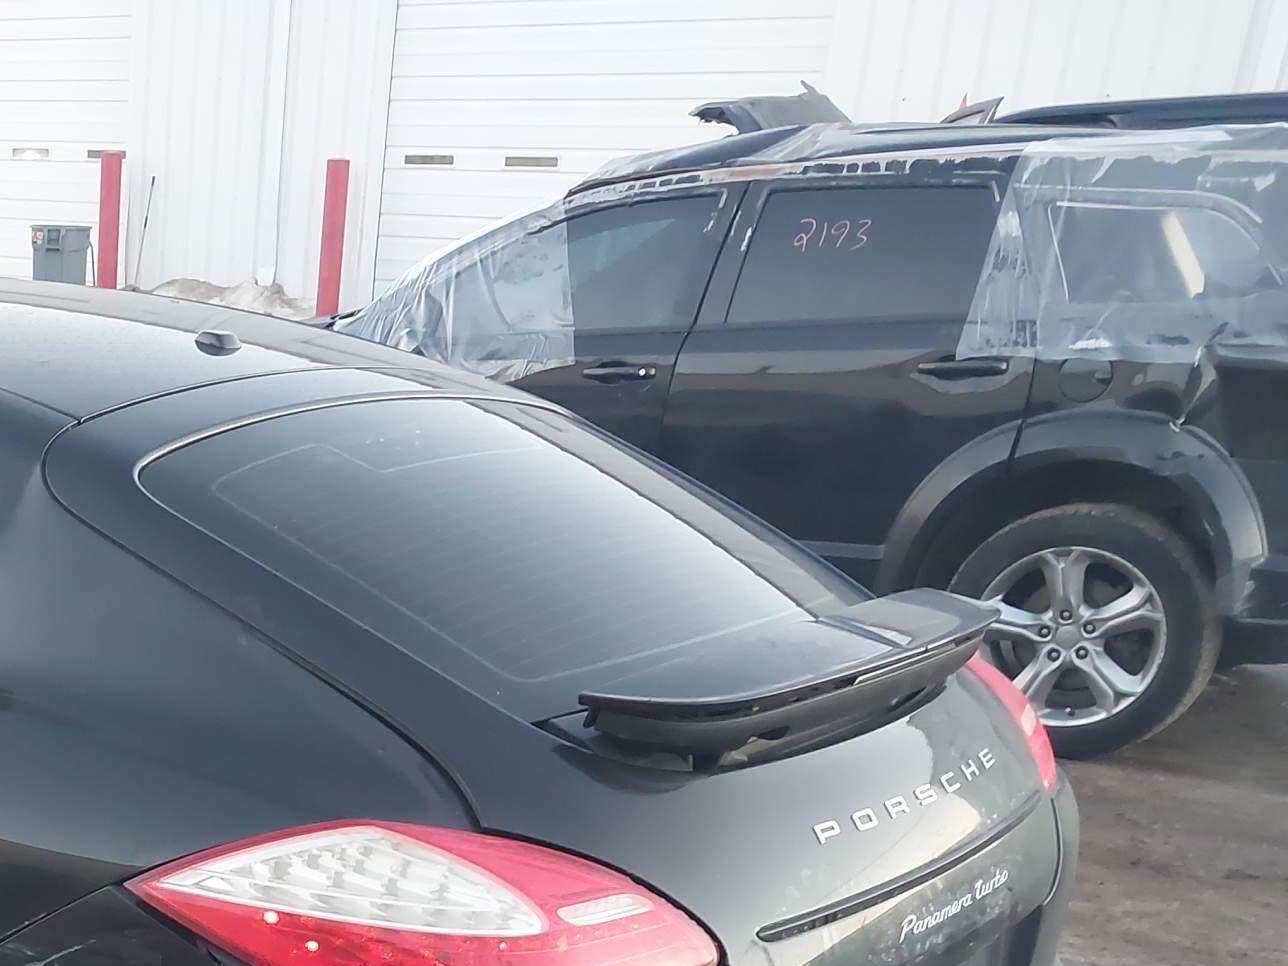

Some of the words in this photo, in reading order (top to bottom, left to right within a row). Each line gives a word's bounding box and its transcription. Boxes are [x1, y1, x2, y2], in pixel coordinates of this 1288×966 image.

[793, 218, 872, 252] 2193
[813, 748, 996, 844] PORSCHE
[898, 894, 973, 944] Panamera
